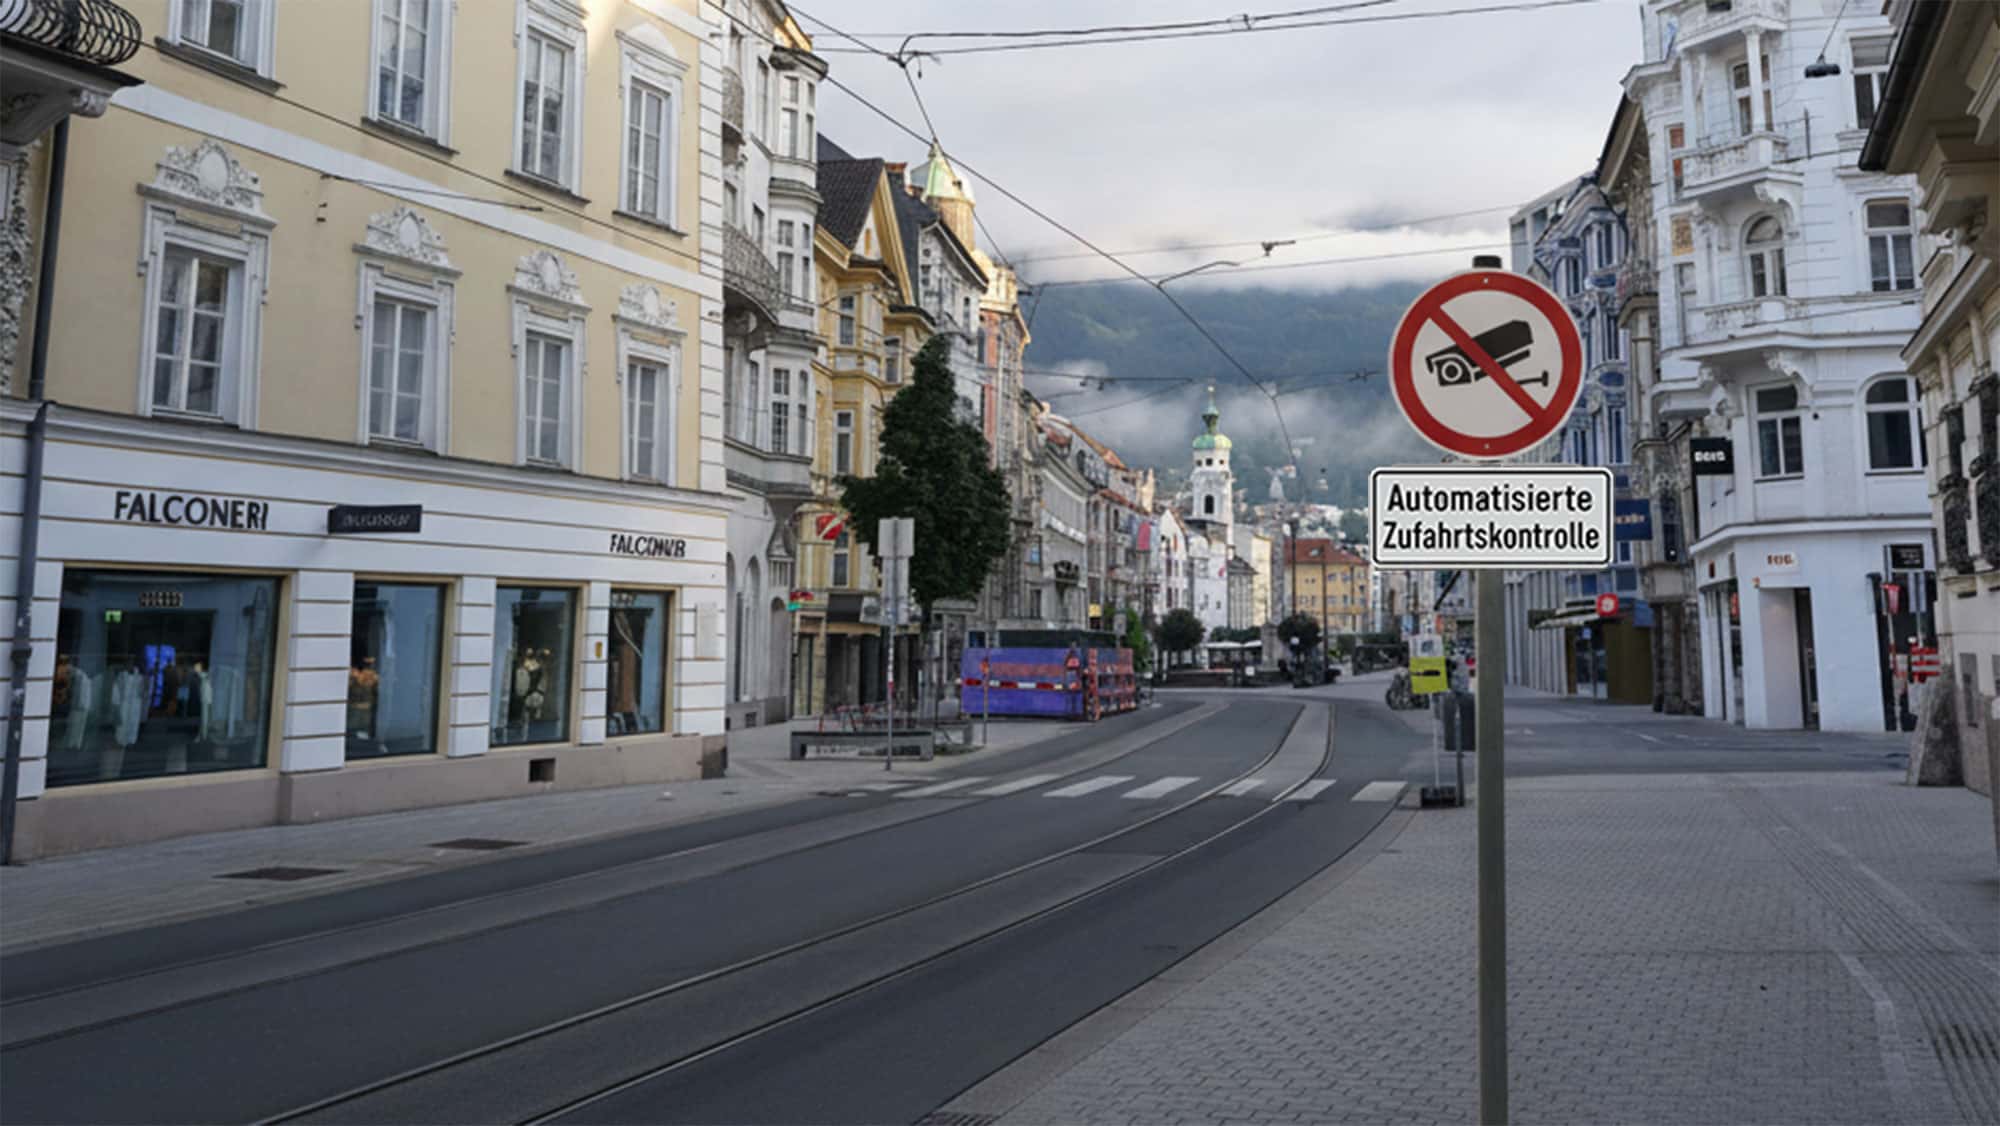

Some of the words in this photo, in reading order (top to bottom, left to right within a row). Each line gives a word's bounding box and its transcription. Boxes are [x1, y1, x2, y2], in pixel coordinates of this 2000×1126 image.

[114, 491, 269, 530] FALCONERI
[1387, 484, 1593, 512] Automatisierte
[1383, 521, 1600, 550] Zufahrtskontrolle
